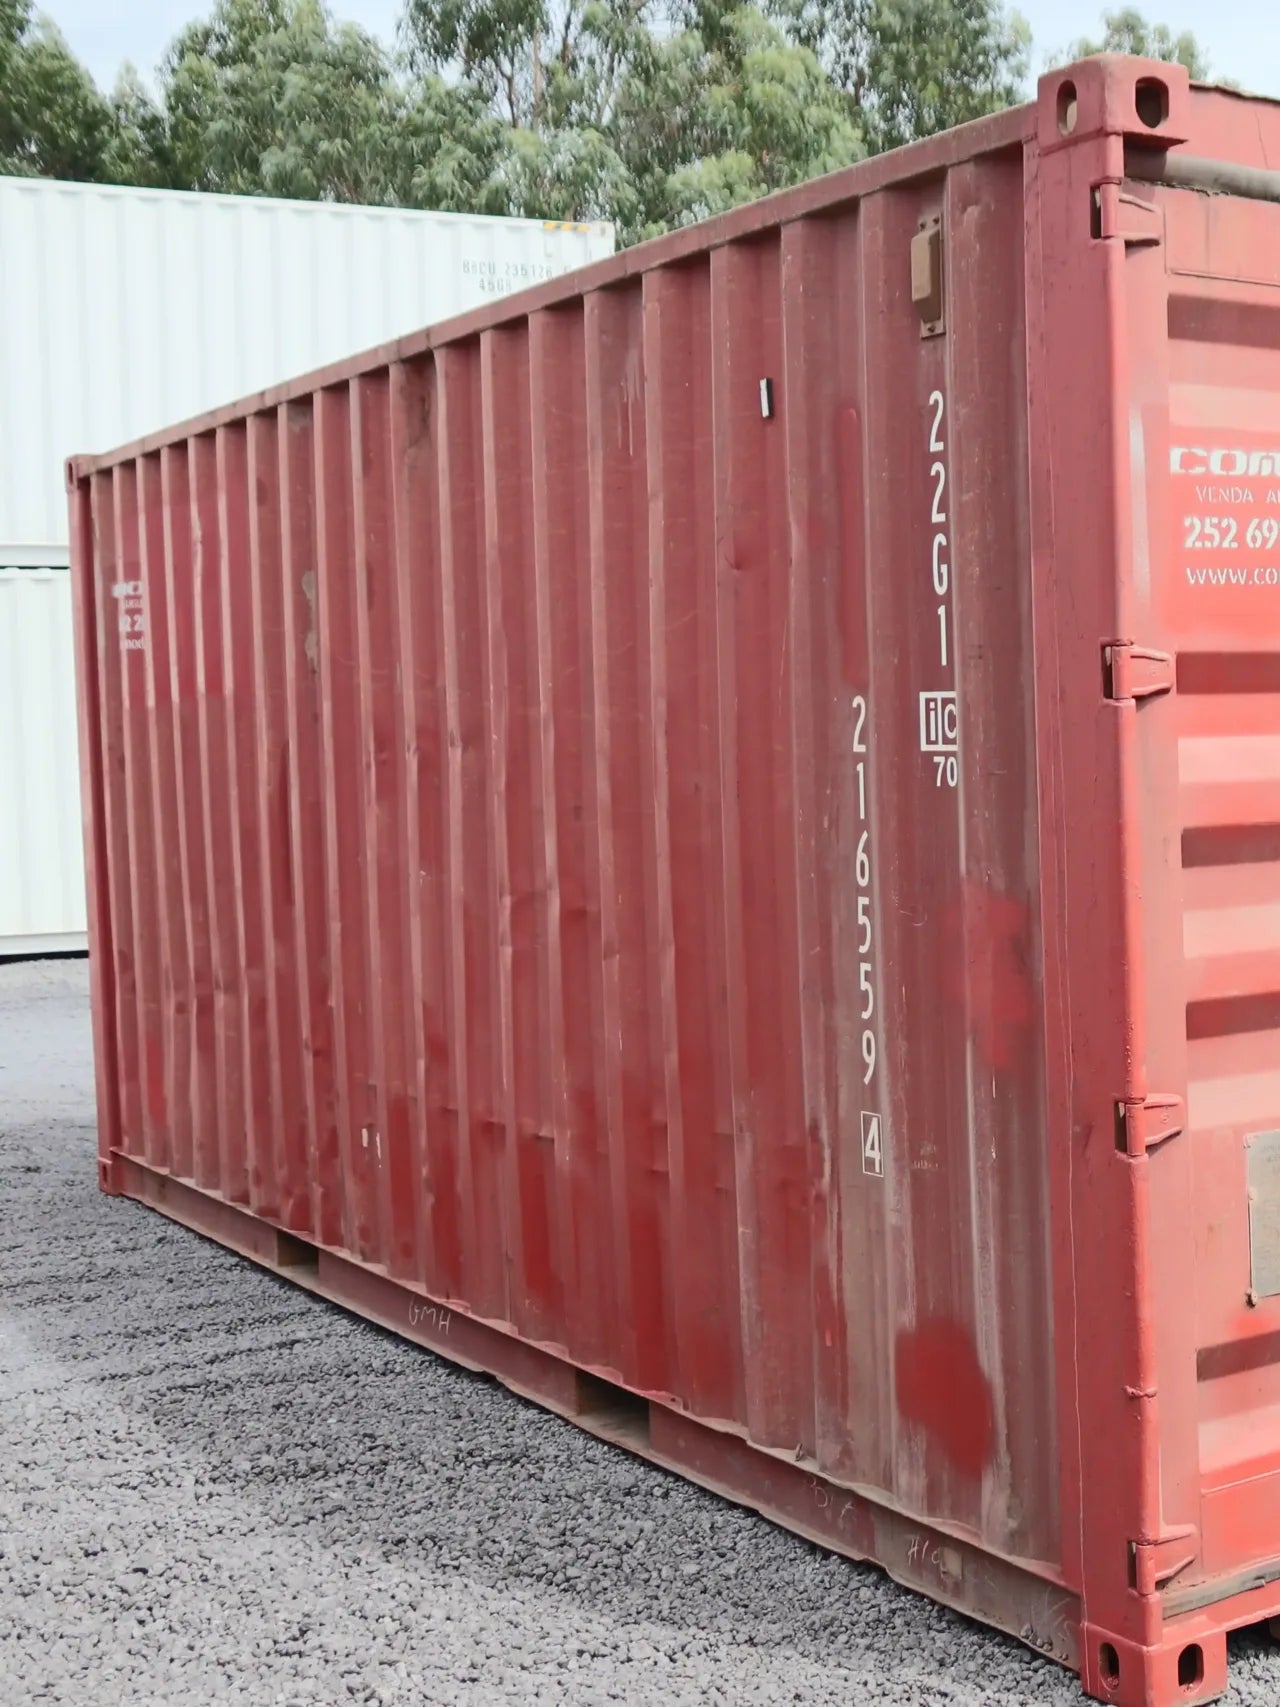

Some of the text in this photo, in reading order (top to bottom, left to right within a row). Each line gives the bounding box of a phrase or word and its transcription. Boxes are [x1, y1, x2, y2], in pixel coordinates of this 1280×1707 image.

[1196, 486, 1254, 503] VENDA
[928, 390, 948, 666] 22G1
[1184, 515, 1239, 549] 252
[933, 756, 957, 787] 70
[852, 696, 876, 1085] 216559
